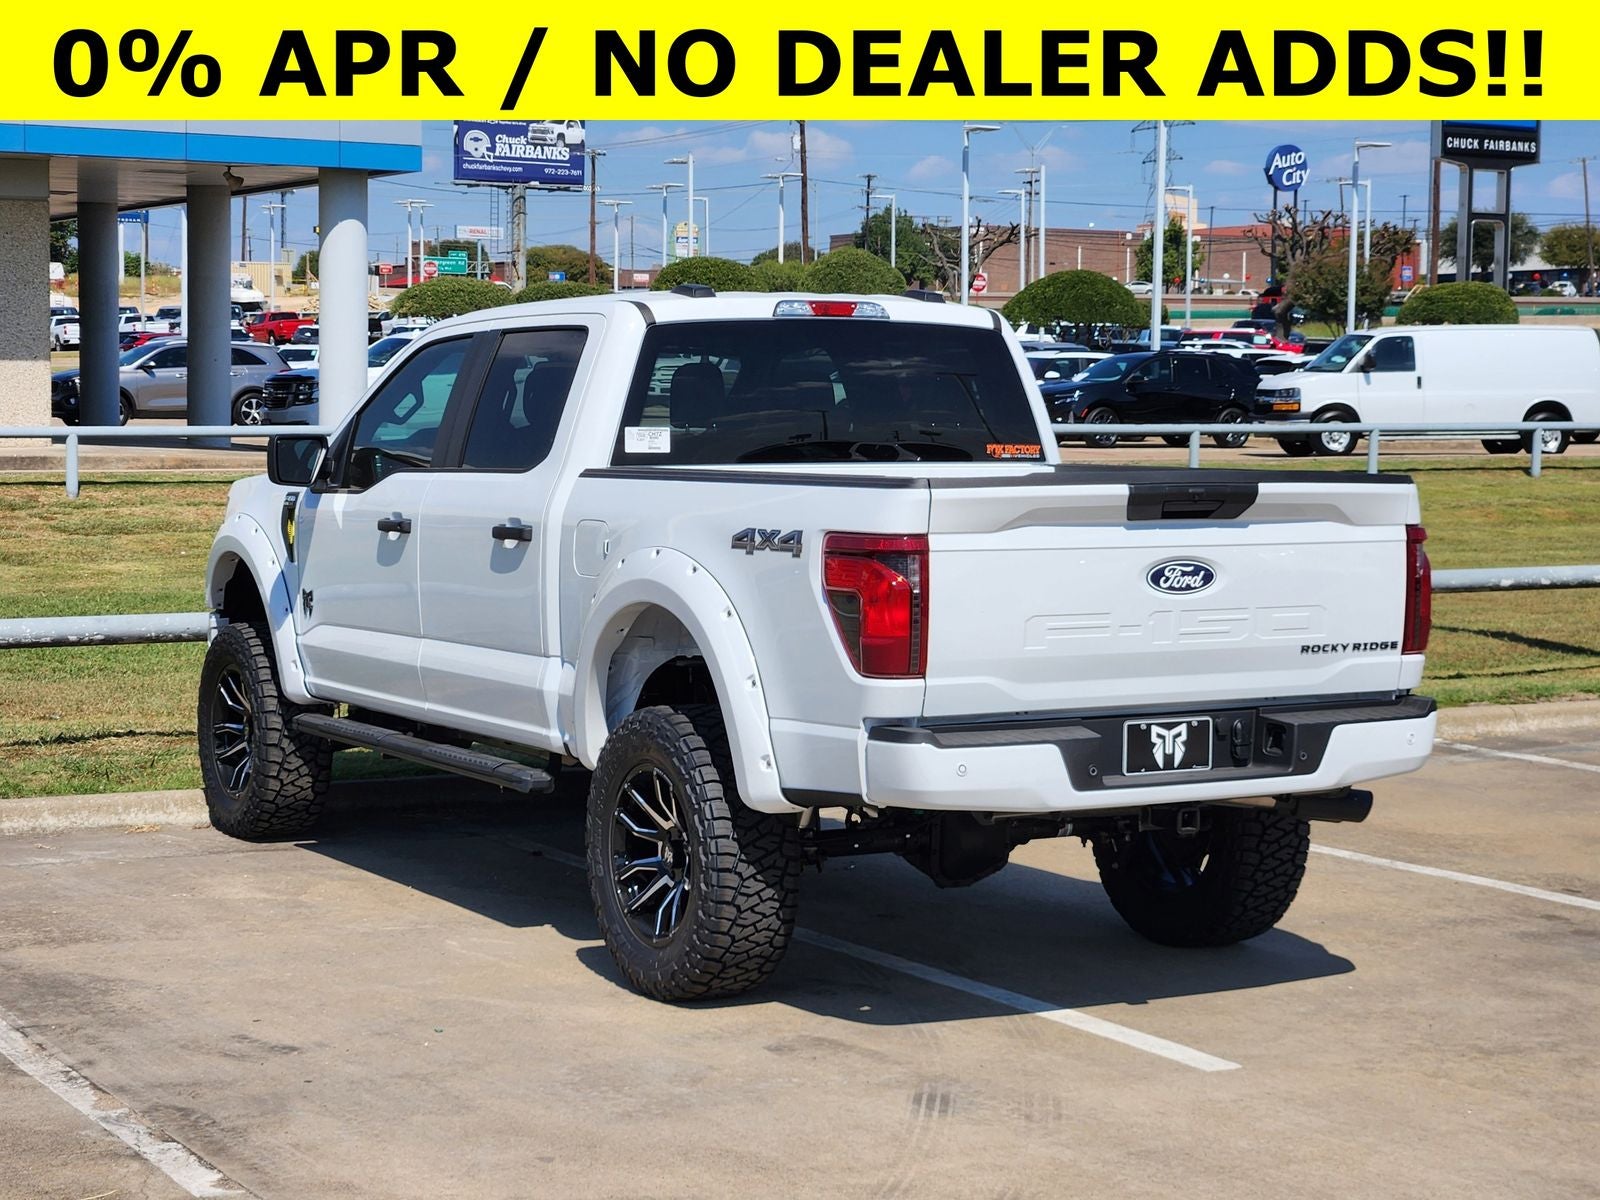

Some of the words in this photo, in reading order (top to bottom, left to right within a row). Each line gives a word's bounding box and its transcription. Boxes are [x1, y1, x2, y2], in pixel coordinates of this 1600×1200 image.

[495, 134, 527, 145] Chuck
[1446, 137, 1480, 150] CHUCK
[1483, 139, 1537, 153] FAIRBANKS
[495, 143, 570, 160] FAIRBANKS
[463, 163, 523, 173] chuckfairbankschevy.com
[1269, 151, 1305, 175] Auto
[1282, 167, 1310, 186] City
[1004, 445, 1041, 454] FACTORY
[1160, 565, 1206, 588] Ford
[1024, 605, 1327, 650] F-150
[1300, 643, 1350, 654] ROCKY
[1352, 641, 1399, 652] RIDGE
